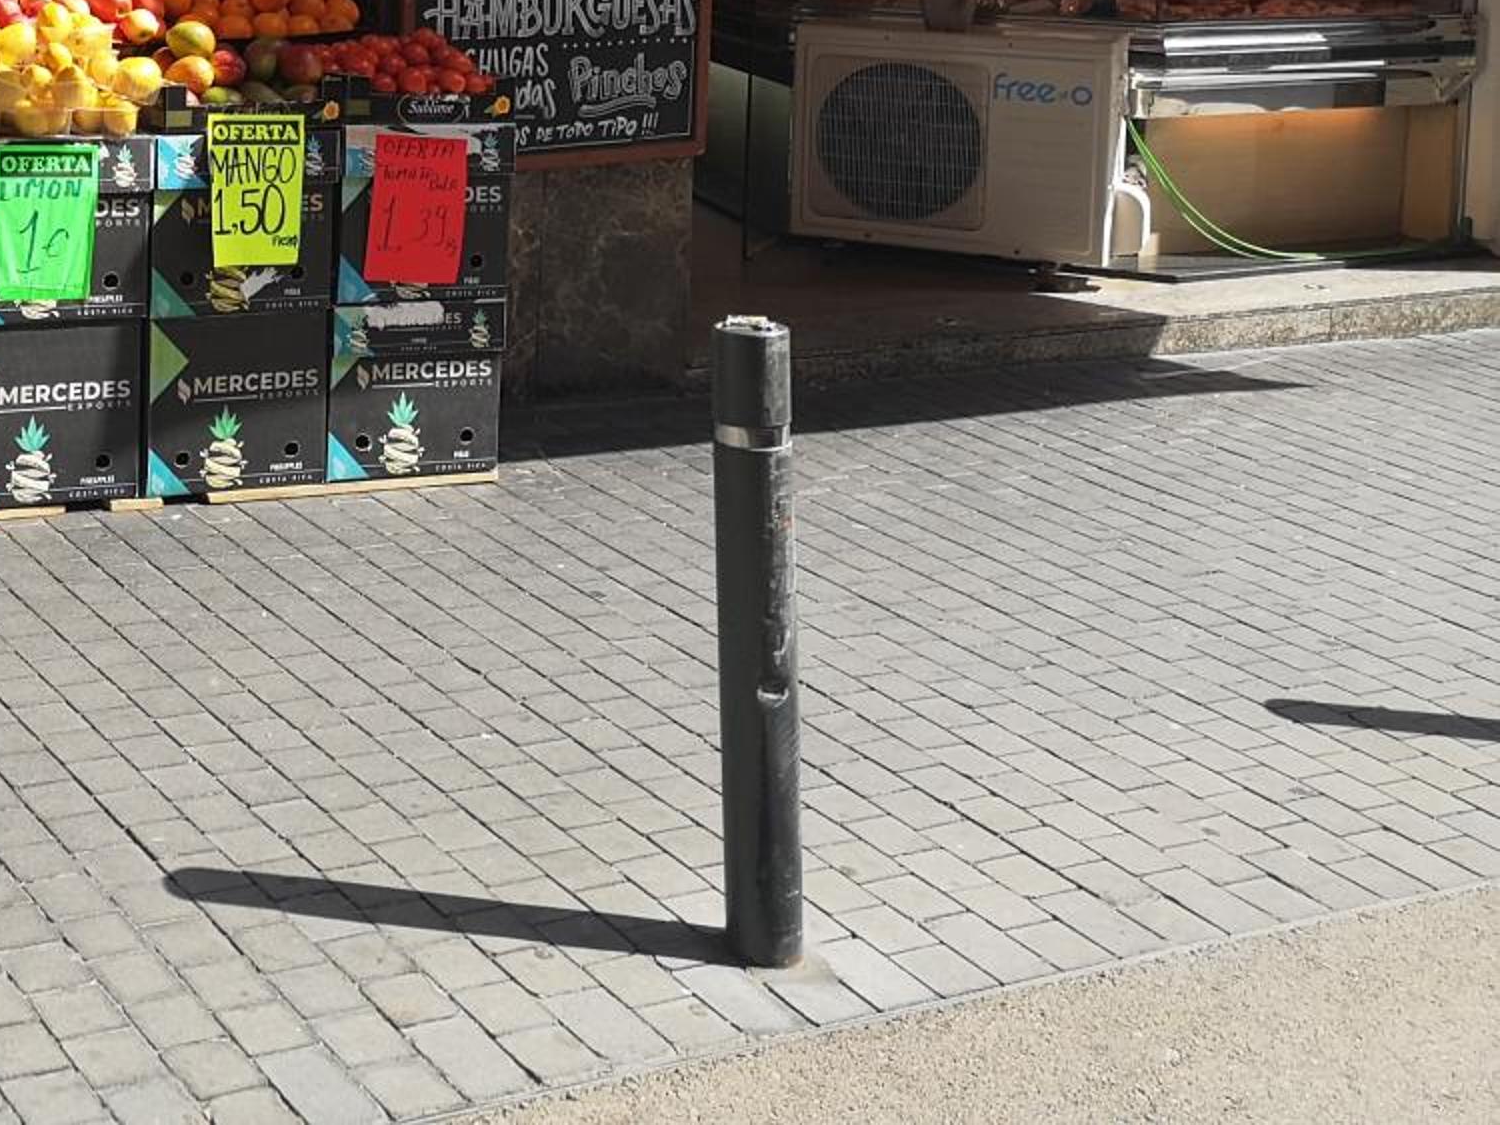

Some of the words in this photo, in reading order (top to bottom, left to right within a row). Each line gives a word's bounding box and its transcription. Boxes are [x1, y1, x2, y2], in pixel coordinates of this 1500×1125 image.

[213, 124, 299, 142] OFERTA
[2, 156, 91, 173] OFERTA
[210, 147, 297, 187] MANGO
[0, 179, 83, 201] LIMON
[371, 359, 493, 381] MERCEDES
[193, 368, 320, 396] MERCEDES
